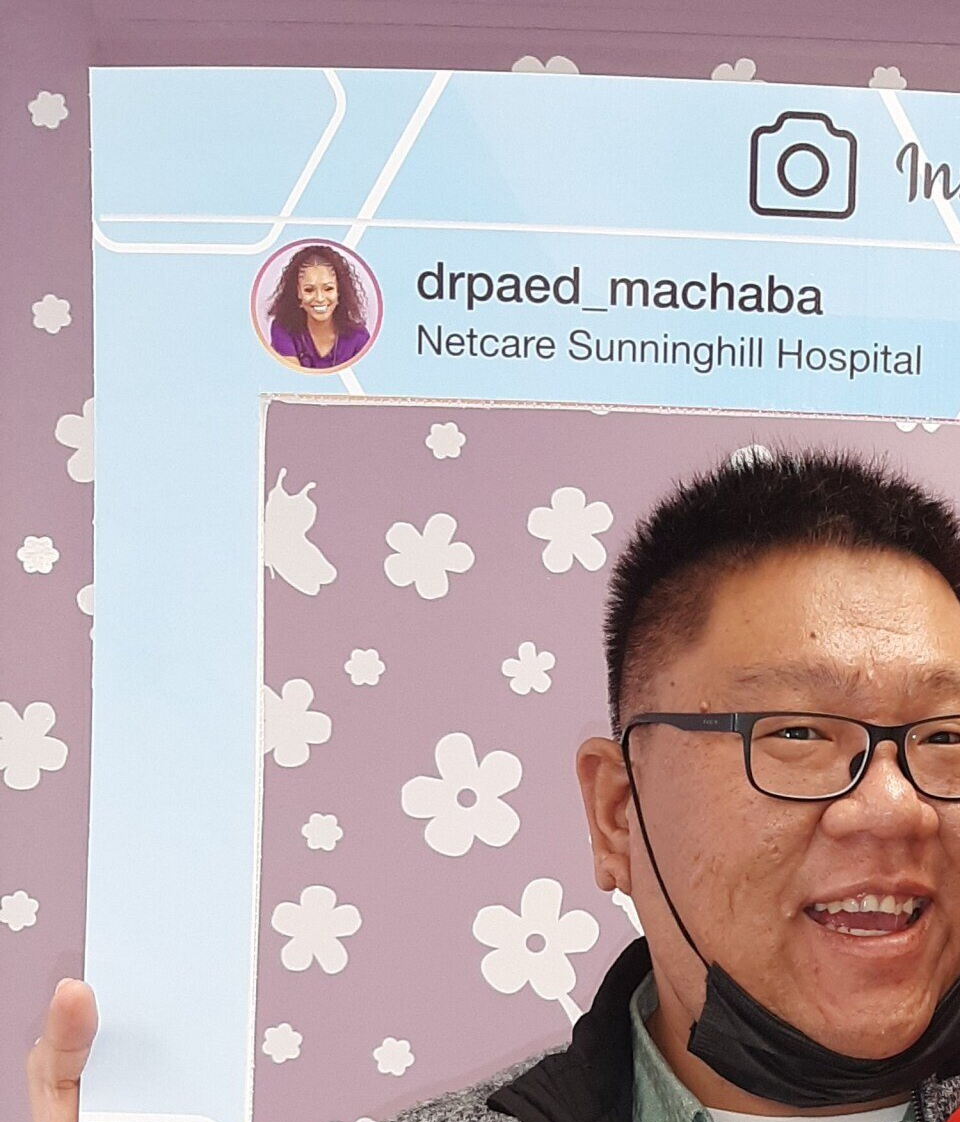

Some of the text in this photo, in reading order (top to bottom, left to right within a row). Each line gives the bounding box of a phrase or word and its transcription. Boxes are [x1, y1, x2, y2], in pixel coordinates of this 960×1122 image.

[418, 262, 823, 315] drpaed_machaba
[418, 325, 921, 379] Netcare Sunninghill Hospital
